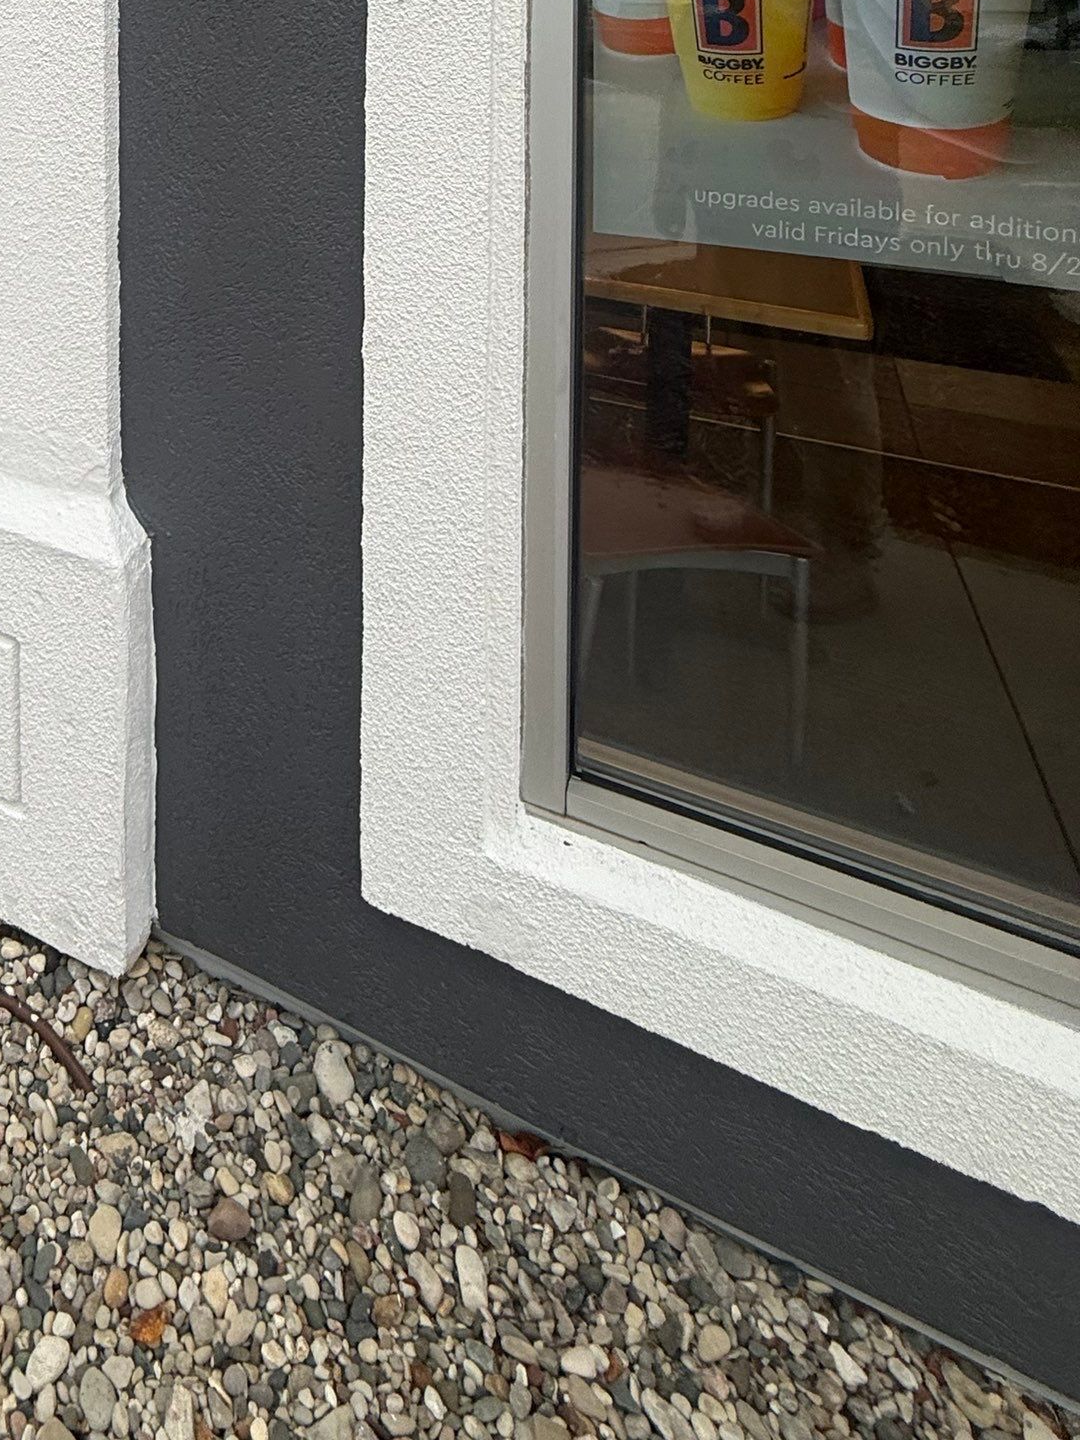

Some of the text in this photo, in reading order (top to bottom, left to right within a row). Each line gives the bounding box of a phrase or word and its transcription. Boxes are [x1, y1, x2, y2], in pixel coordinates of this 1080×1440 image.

[894, 53, 977, 69] BIGGBY
[895, 71, 975, 86] COFFEE
[694, 188, 1080, 244] upgrades available for addition
[752, 220, 1080, 276] valid Fridays only thru 8/2
